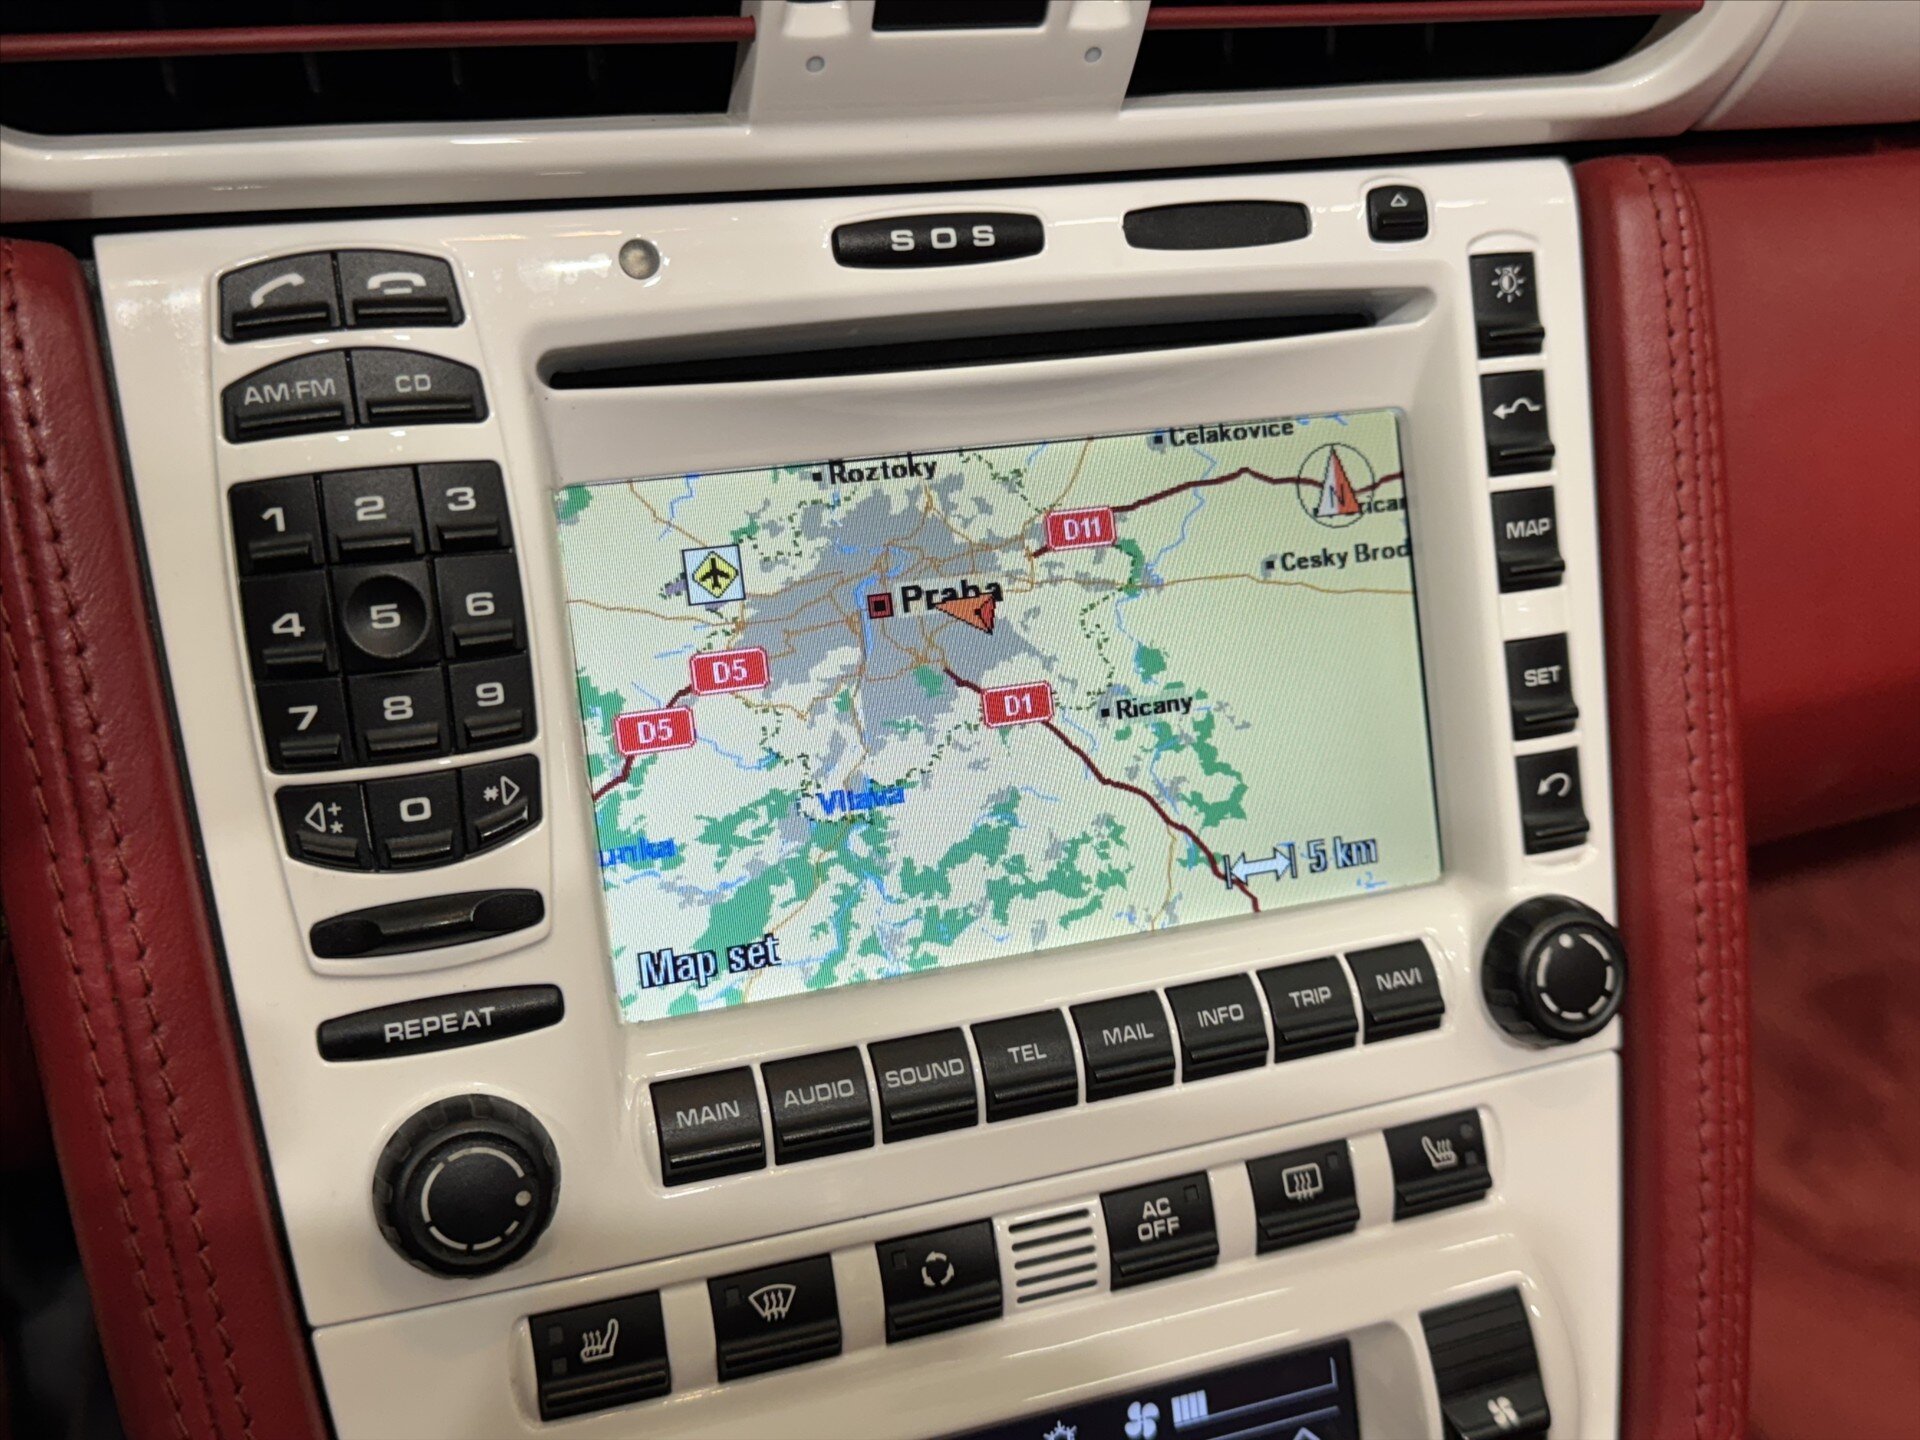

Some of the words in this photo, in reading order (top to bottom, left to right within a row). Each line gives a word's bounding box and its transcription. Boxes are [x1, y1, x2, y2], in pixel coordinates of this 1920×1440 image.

[394, 373, 432, 393] CD
[828, 452, 937, 485] Roztoky
[261, 506, 286, 532] 1
[354, 495, 388, 521] 2
[445, 486, 477, 512] 3
[1063, 516, 1102, 542] D11
[1506, 517, 1551, 540] MAP
[1281, 548, 1348, 571] Cesky
[271, 612, 306, 638] 4
[370, 603, 401, 630] 5
[465, 591, 495, 617] 6
[711, 657, 747, 686] D5
[1524, 664, 1561, 688] SET
[288, 705, 318, 731] 7
[383, 695, 413, 721] 8
[475, 682, 505, 707] 9
[1003, 692, 1033, 718] D1
[1116, 696, 1193, 720] Ricany
[637, 716, 674, 745] D5
[1307, 838, 1328, 873] 5
[1333, 835, 1378, 870] km
[638, 947, 718, 989] Map
[727, 932, 782, 973] set
[1376, 967, 1423, 990] NAVI
[1288, 985, 1332, 1008] TRIP
[384, 1007, 496, 1043] REPEAT
[1197, 1003, 1245, 1028] INFO
[1102, 1022, 1155, 1046] MAIL
[1006, 1042, 1048, 1064] TEL
[885, 1057, 965, 1088] SOUND
[783, 1078, 855, 1109] AUDIO
[676, 1100, 741, 1129] MAIN
[1142, 1197, 1172, 1220] AC
[1137, 1216, 1180, 1242] OFF
